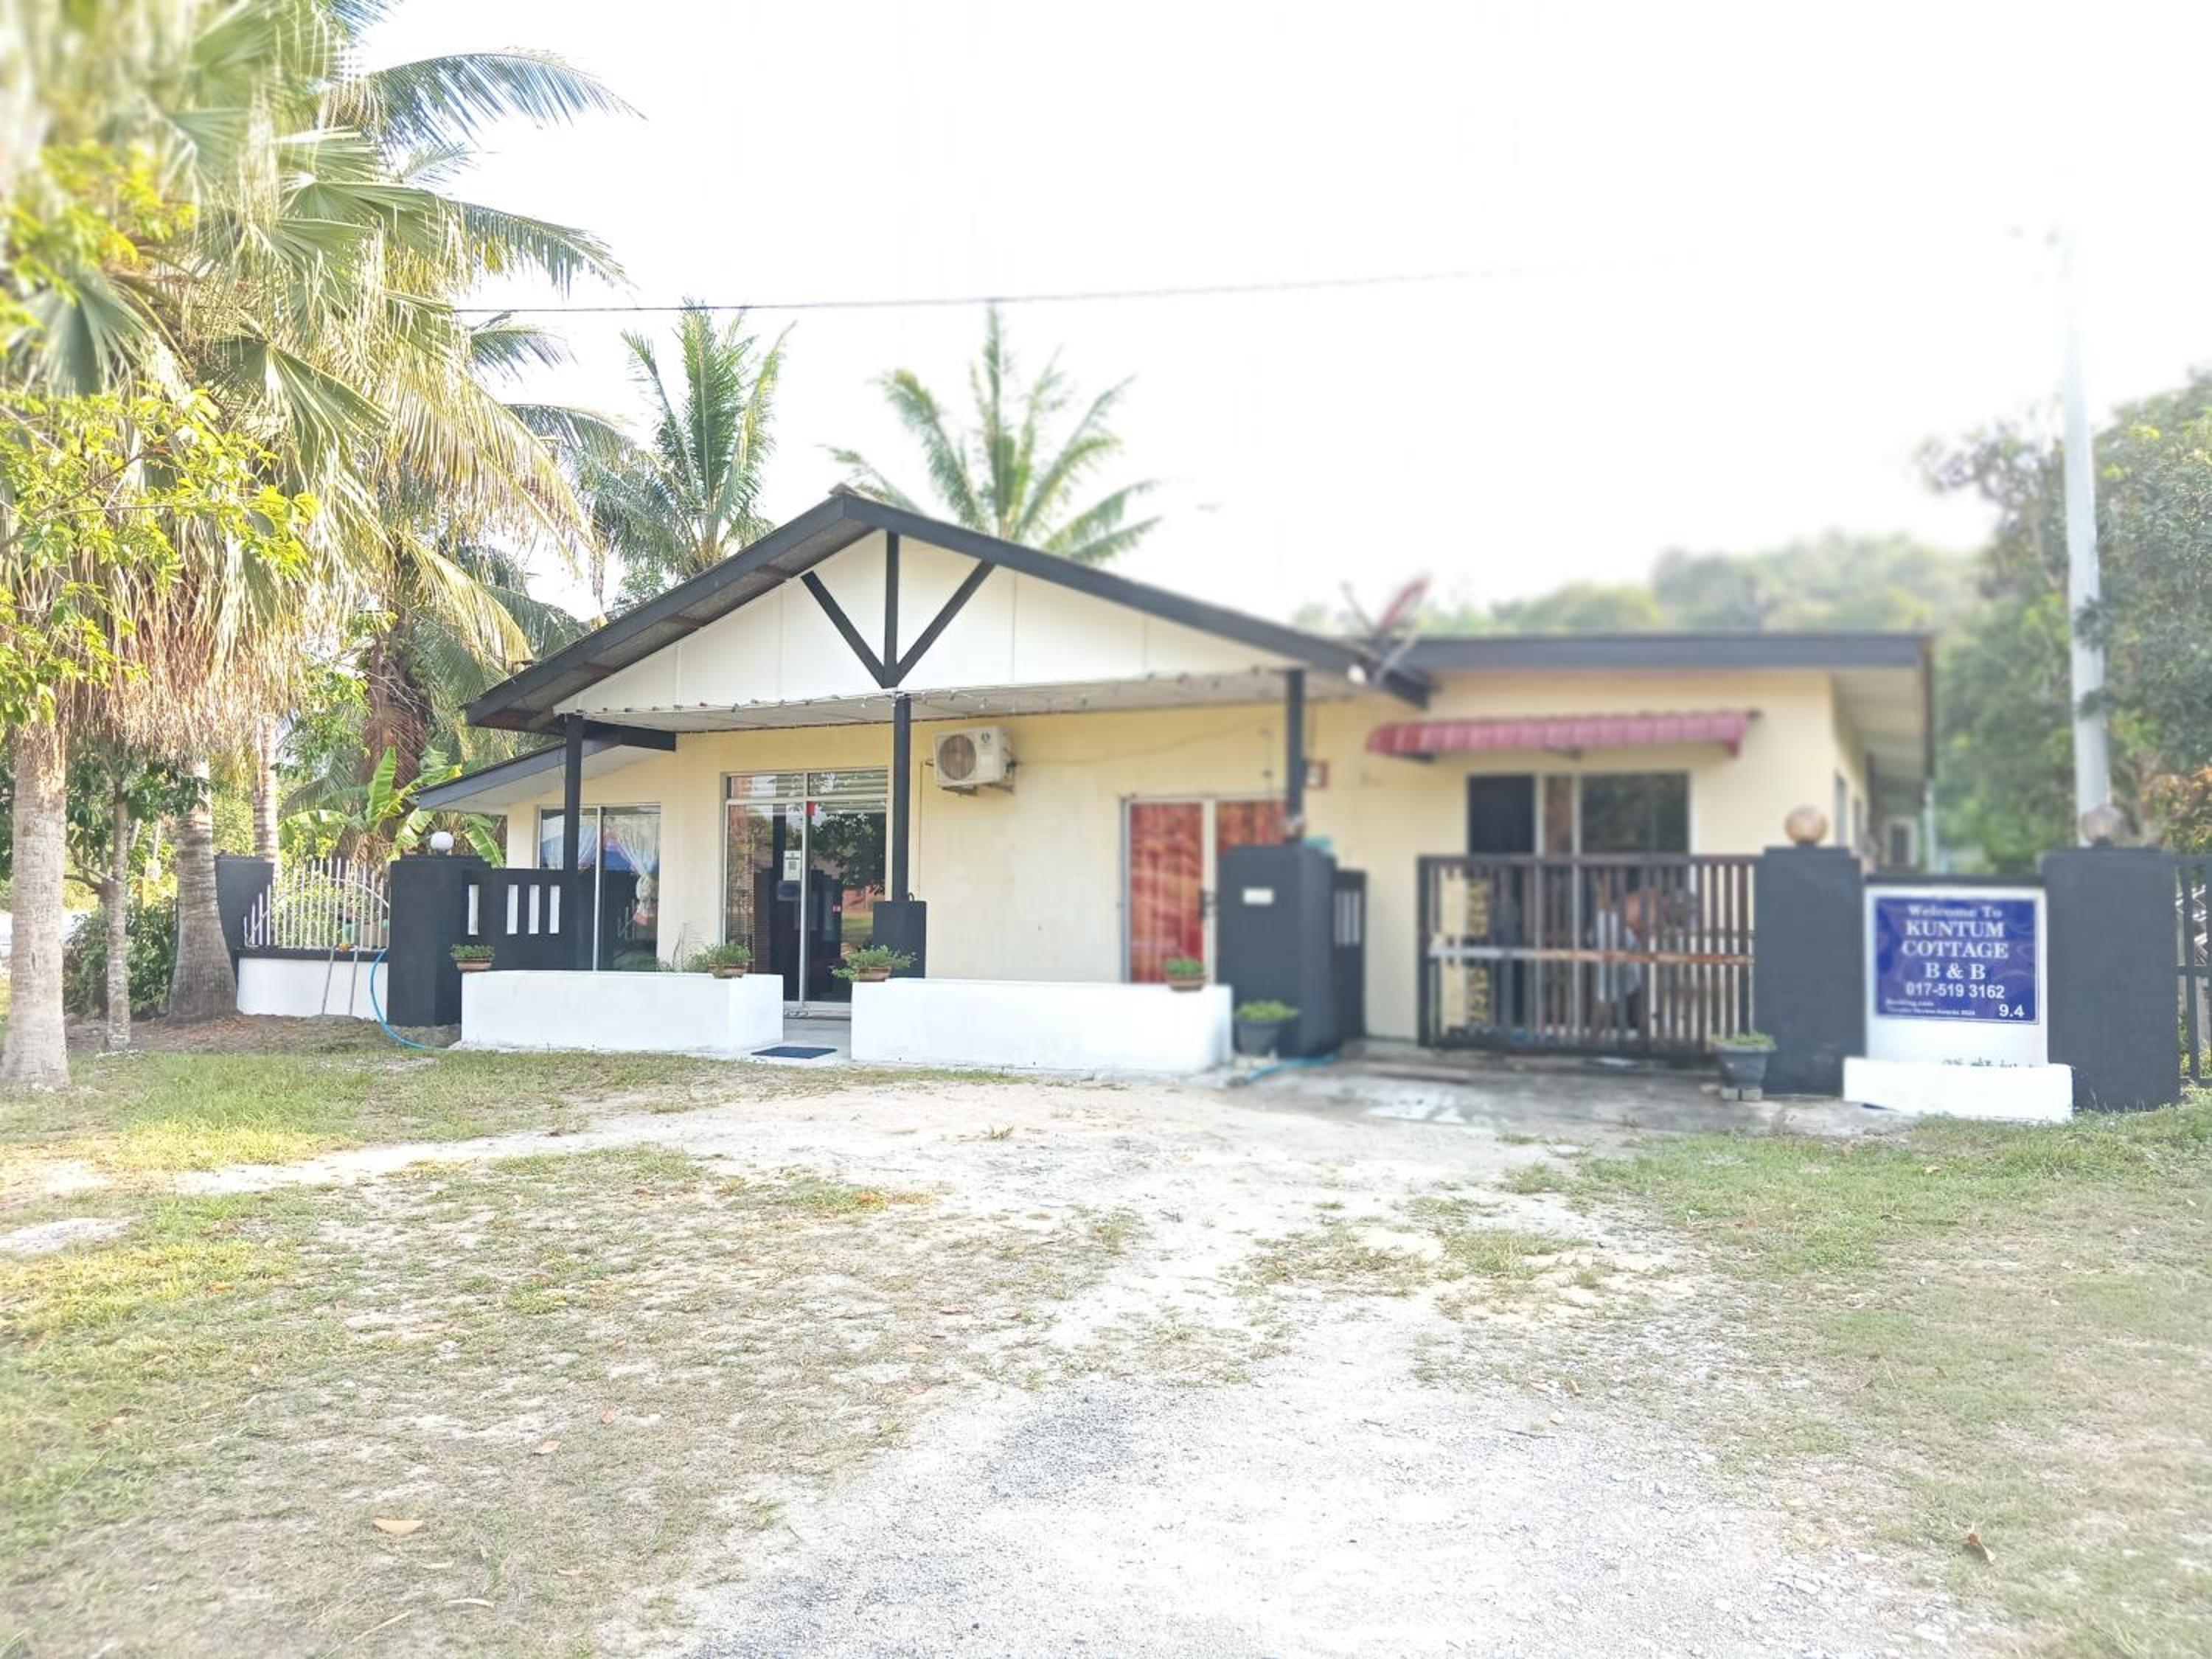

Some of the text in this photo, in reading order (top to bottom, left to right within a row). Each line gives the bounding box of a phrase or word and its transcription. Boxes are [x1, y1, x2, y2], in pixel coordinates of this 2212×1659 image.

[1909, 905, 2003, 917] Welcome To
[1907, 920, 2005, 937] KUNTUM
[1902, 940, 2008, 958] COTTAGE
[1925, 962, 1986, 980] B & B
[1906, 982, 2005, 999] 017-519 3162
[1999, 1004, 2025, 1018] 9.4
